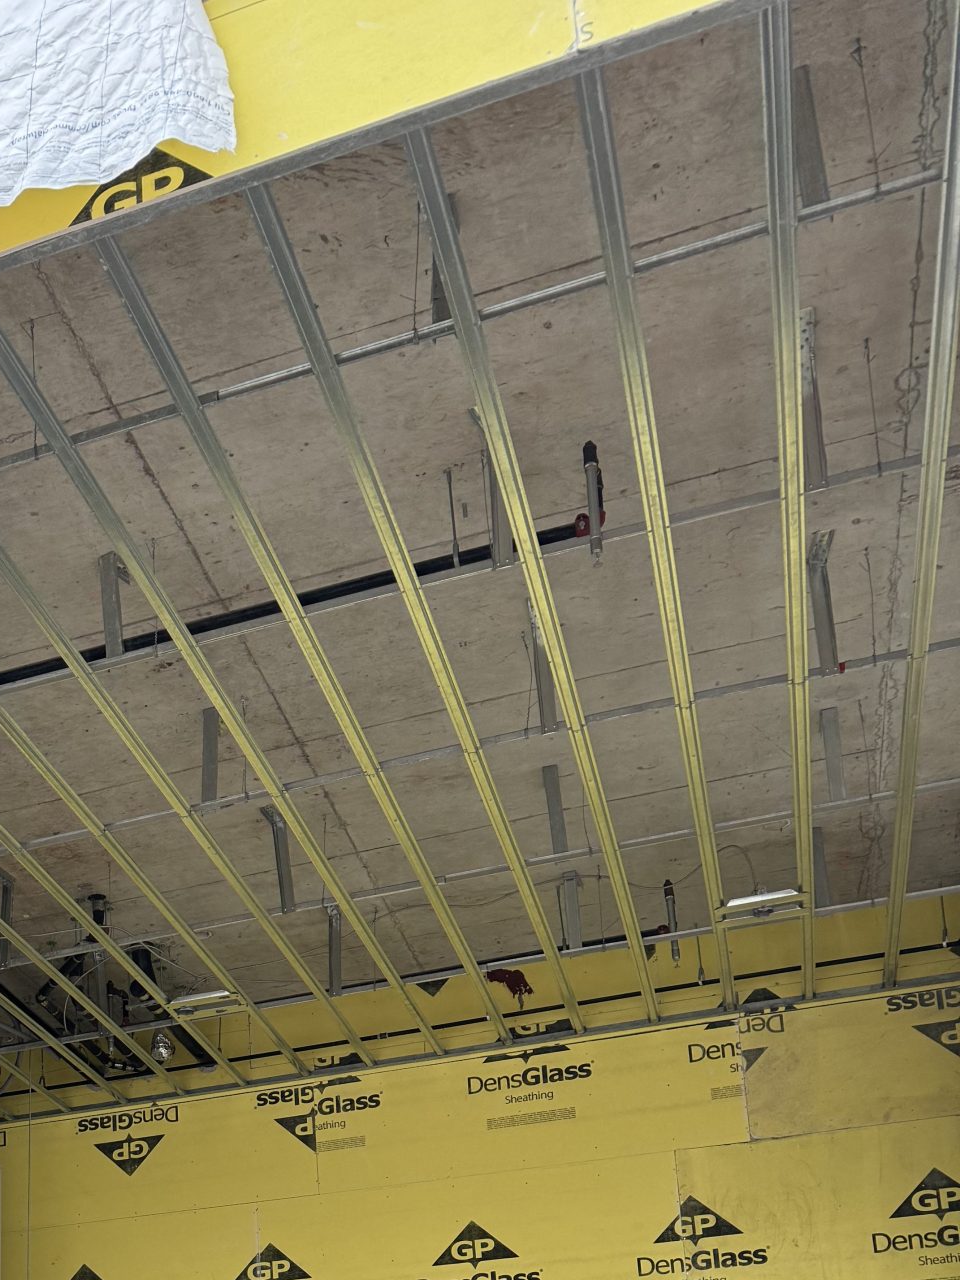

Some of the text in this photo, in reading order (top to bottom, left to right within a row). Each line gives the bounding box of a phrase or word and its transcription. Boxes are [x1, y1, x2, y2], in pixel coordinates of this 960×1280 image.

[91, 166, 185, 220] GP
[467, 1061, 593, 1095] DensGlass
[504, 1091, 554, 1104] Sheathing
[77, 1106, 179, 1133] DensGlass
[112, 1141, 149, 1160] GP
[674, 1214, 717, 1236] GP
[450, 1238, 495, 1261] GP
[871, 1224, 960, 1254] DensG
[247, 1260, 291, 1280] GP
[637, 1247, 768, 1277] DensGlass
